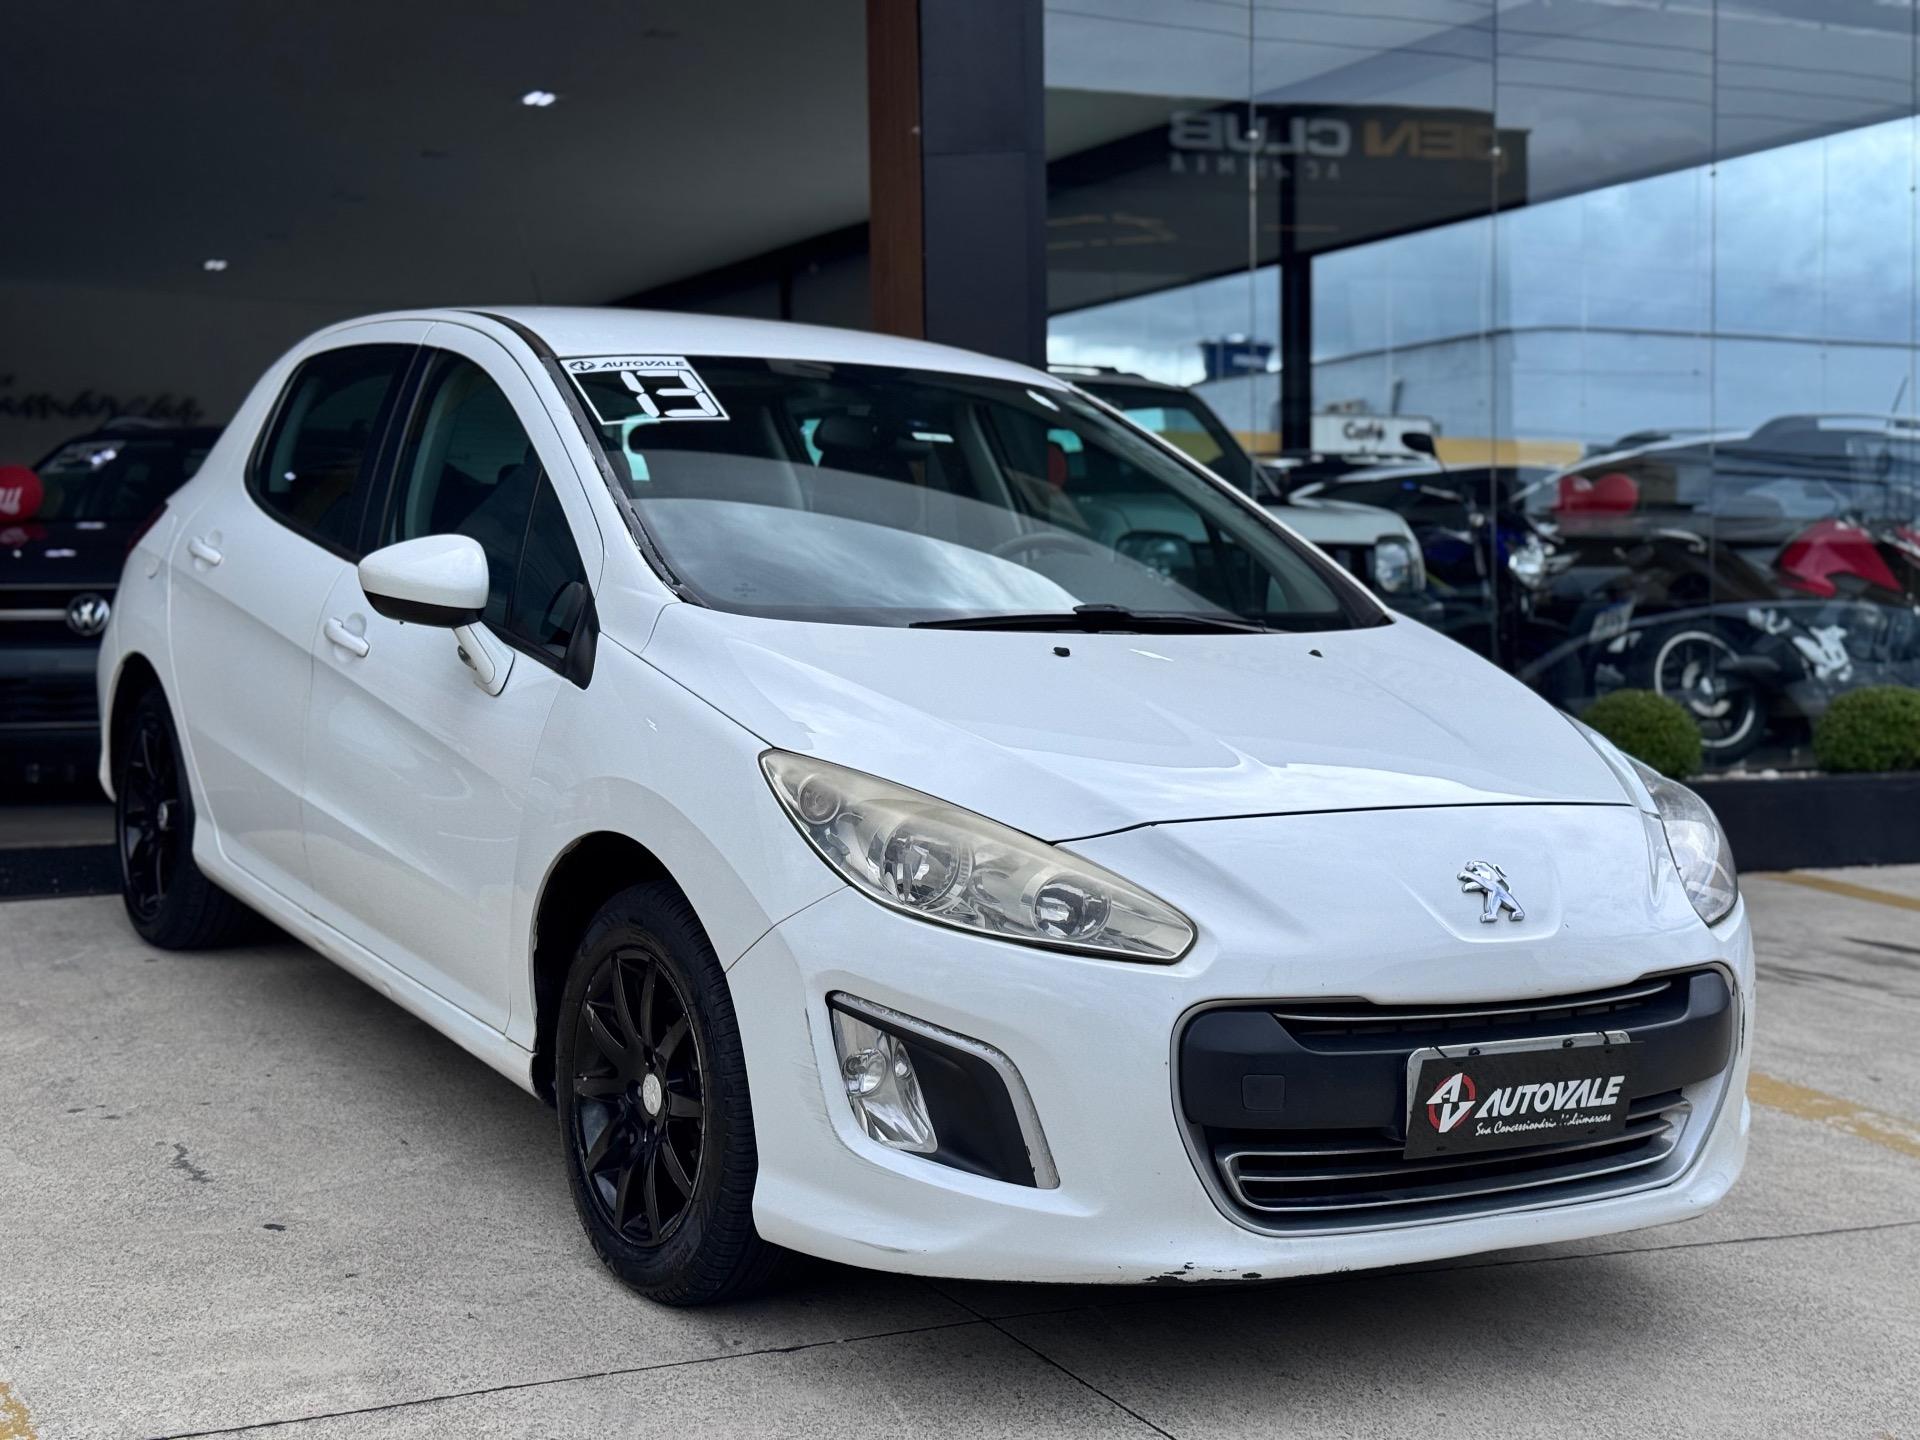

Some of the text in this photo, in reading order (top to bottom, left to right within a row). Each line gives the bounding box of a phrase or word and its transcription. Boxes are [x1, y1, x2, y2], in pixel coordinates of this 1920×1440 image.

[601, 360, 685, 369] AUTOVALE
[620, 370, 719, 418] 13
[1474, 1075, 1625, 1119] AUTOVALE
[1475, 1122, 1492, 1136] Sua
